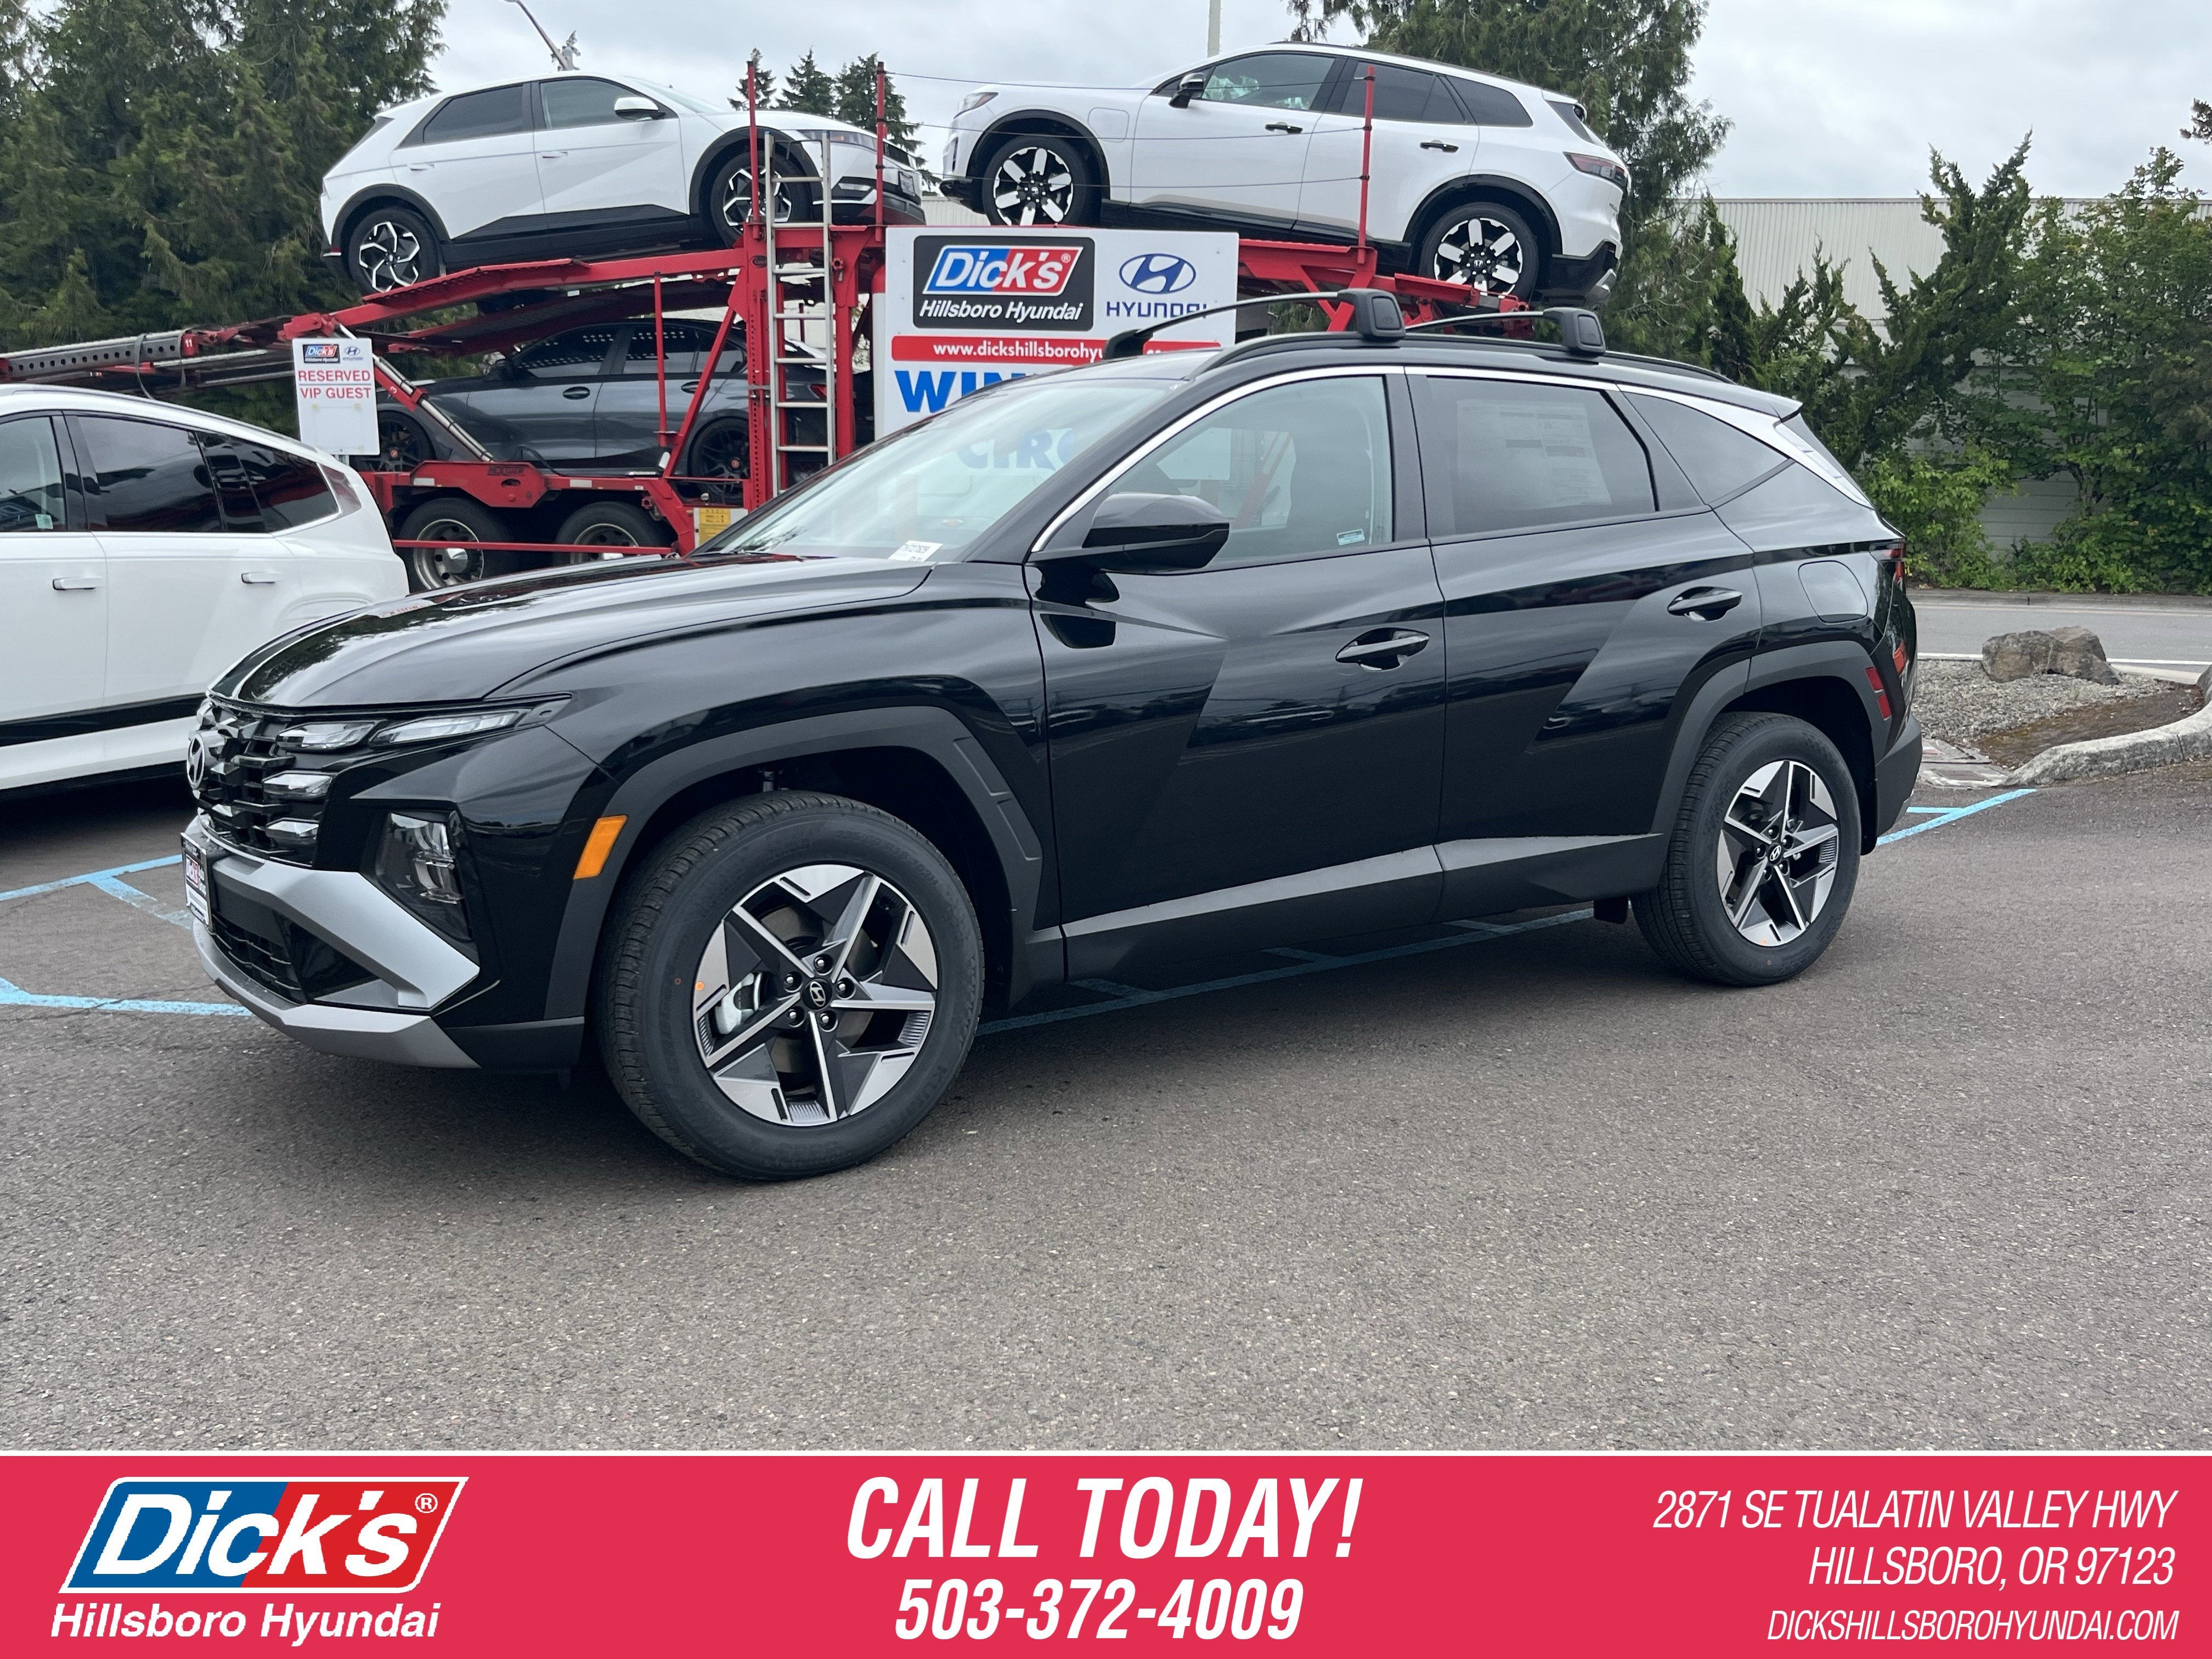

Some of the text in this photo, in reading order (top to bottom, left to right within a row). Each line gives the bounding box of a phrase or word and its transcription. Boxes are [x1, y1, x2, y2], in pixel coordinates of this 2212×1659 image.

[935, 252, 1063, 289] Dick's
[919, 300, 1084, 323] Hillsboro Hyundai
[1106, 301, 1207, 318] HYUNDAI
[298, 370, 370, 381] RESERVED
[300, 387, 371, 398] VIP GUEST
